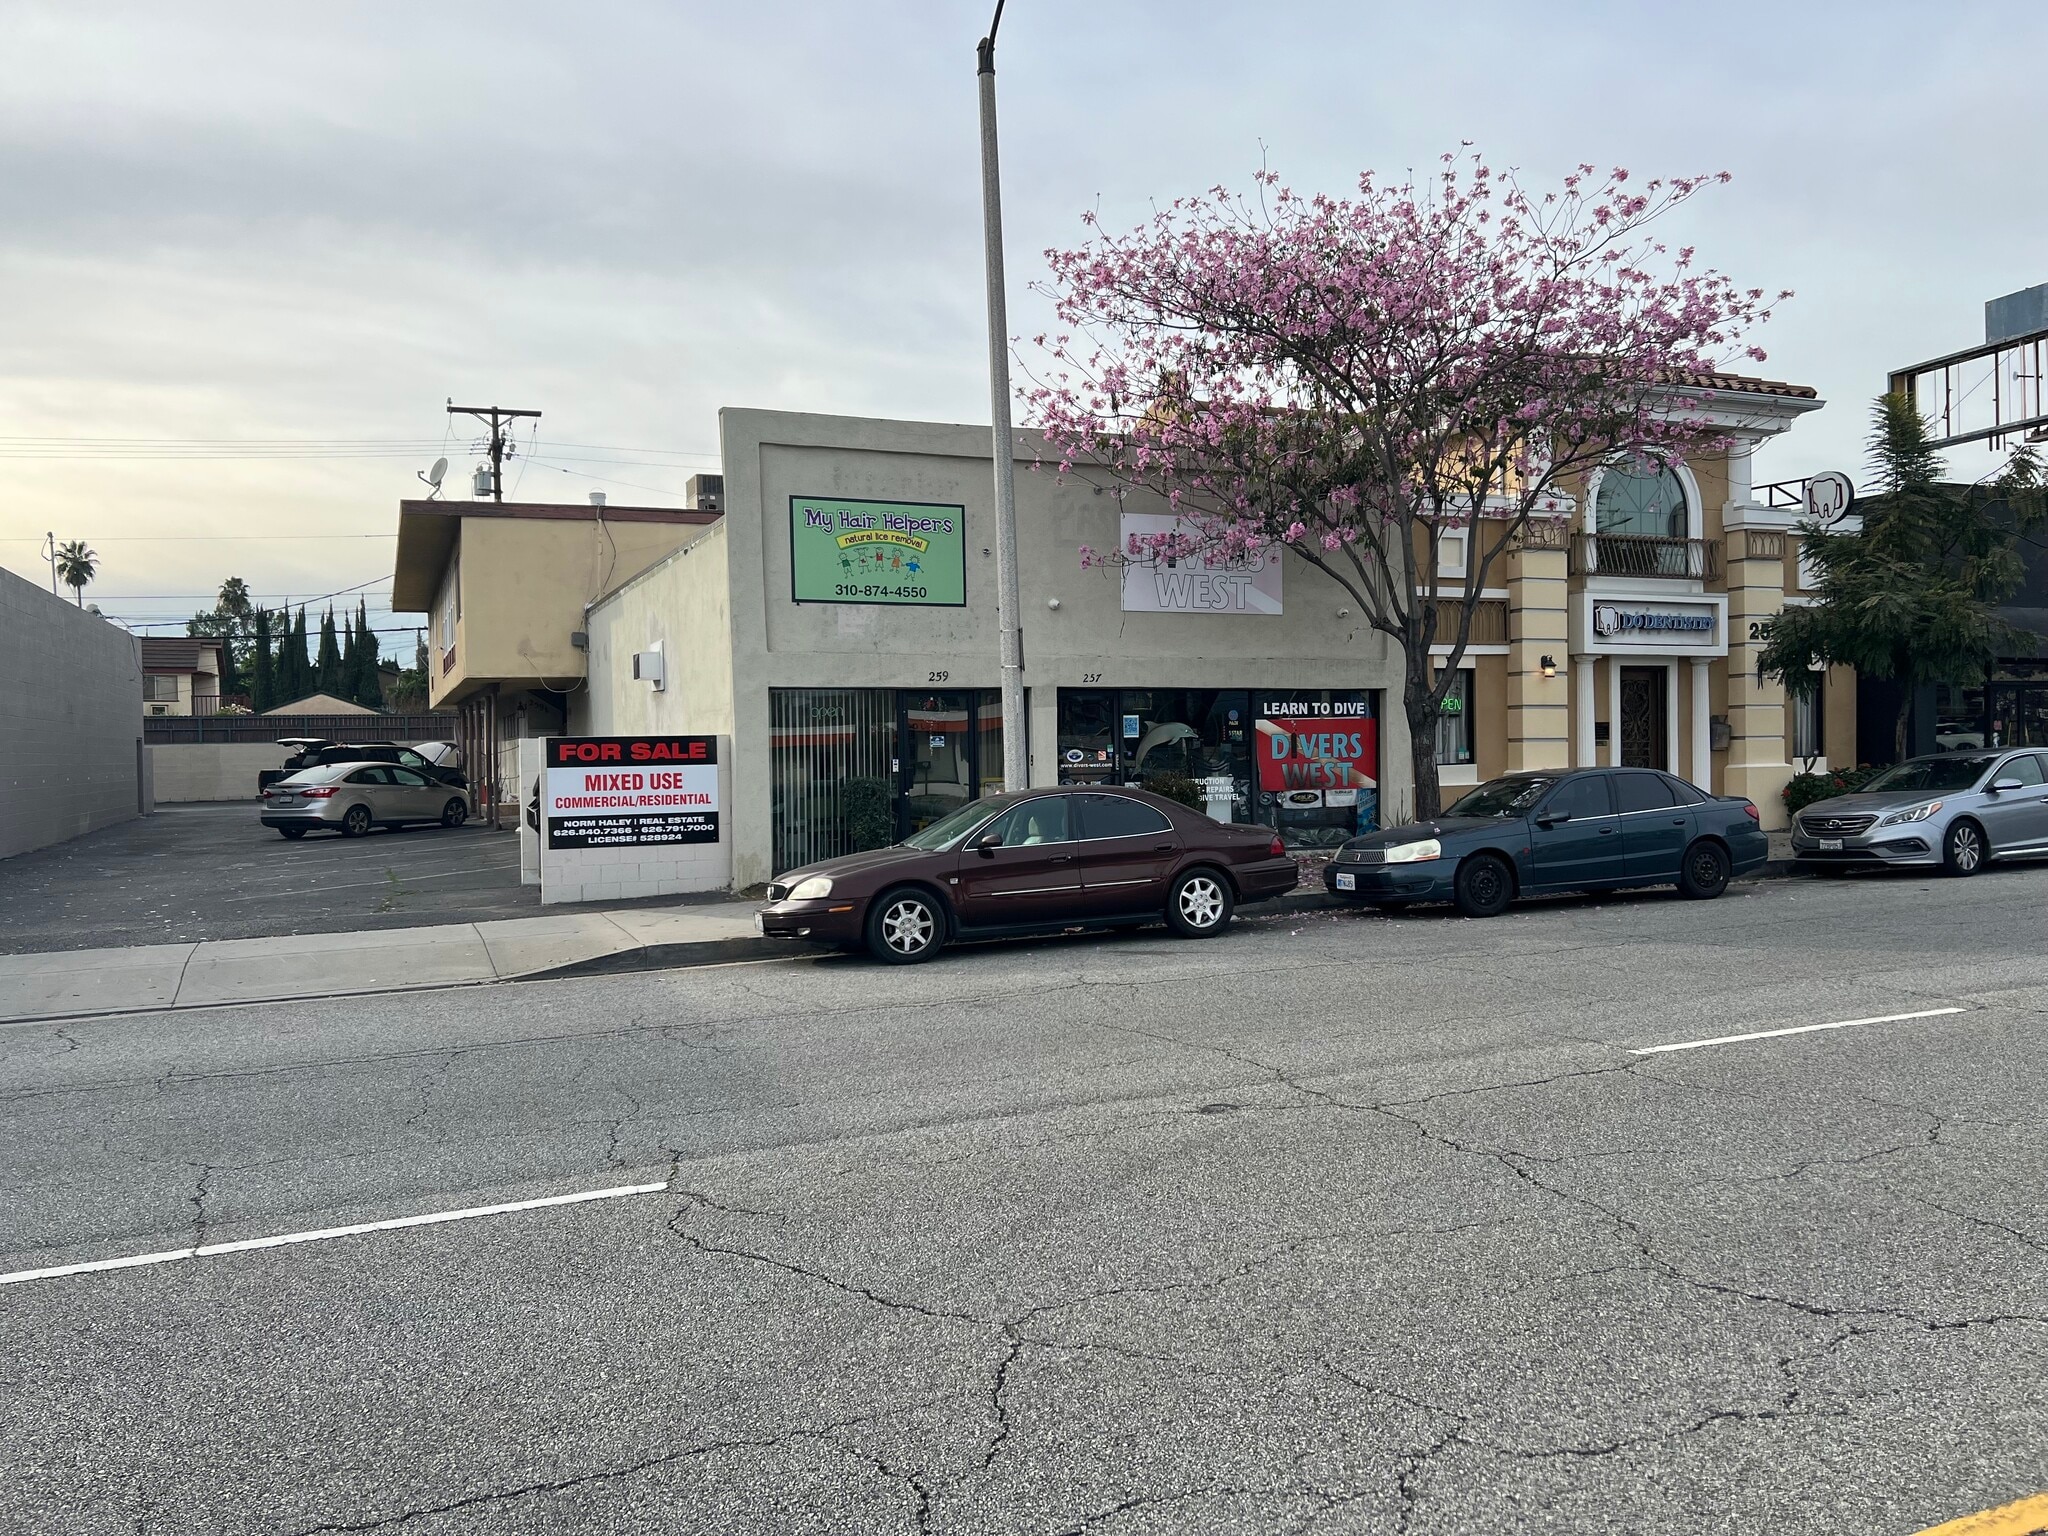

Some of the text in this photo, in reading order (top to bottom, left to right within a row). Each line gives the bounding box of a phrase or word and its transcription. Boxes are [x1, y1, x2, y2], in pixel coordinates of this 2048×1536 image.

[804, 508, 953, 537] My Hair Helpers
[844, 532, 923, 549] natural lice removal
[835, 584, 927, 598] 310-874-4550
[1154, 573, 1252, 610] WEST
[1644, 614, 1716, 630] DENTISTRY
[1750, 622, 1772, 641] 25
[928, 671, 949, 682] 259
[1083, 673, 1102, 683] 257
[1263, 702, 1365, 715] LEARN TO DIVE
[1440, 698, 1462, 710] PEN
[811, 706, 844, 720] open
[559, 742, 707, 761] FOR SALE
[1271, 732, 1363, 760] DIVERS
[1281, 762, 1354, 787] WEST
[585, 772, 683, 792] MIXED USE
[1206, 785, 1234, 793] REPAIRS
[555, 793, 712, 809] COMMERCIAL/RESIDENTIAL
[1215, 793, 1240, 801] TRAVEL
[563, 819, 598, 828] NORM
[599, 818, 632, 826] HALEY
[668, 816, 705, 824] ESTATE
[553, 827, 632, 837] 626.840.7366
[641, 824, 715, 834] 626.791.7000
[588, 833, 682, 844] LICENSE# 528924
